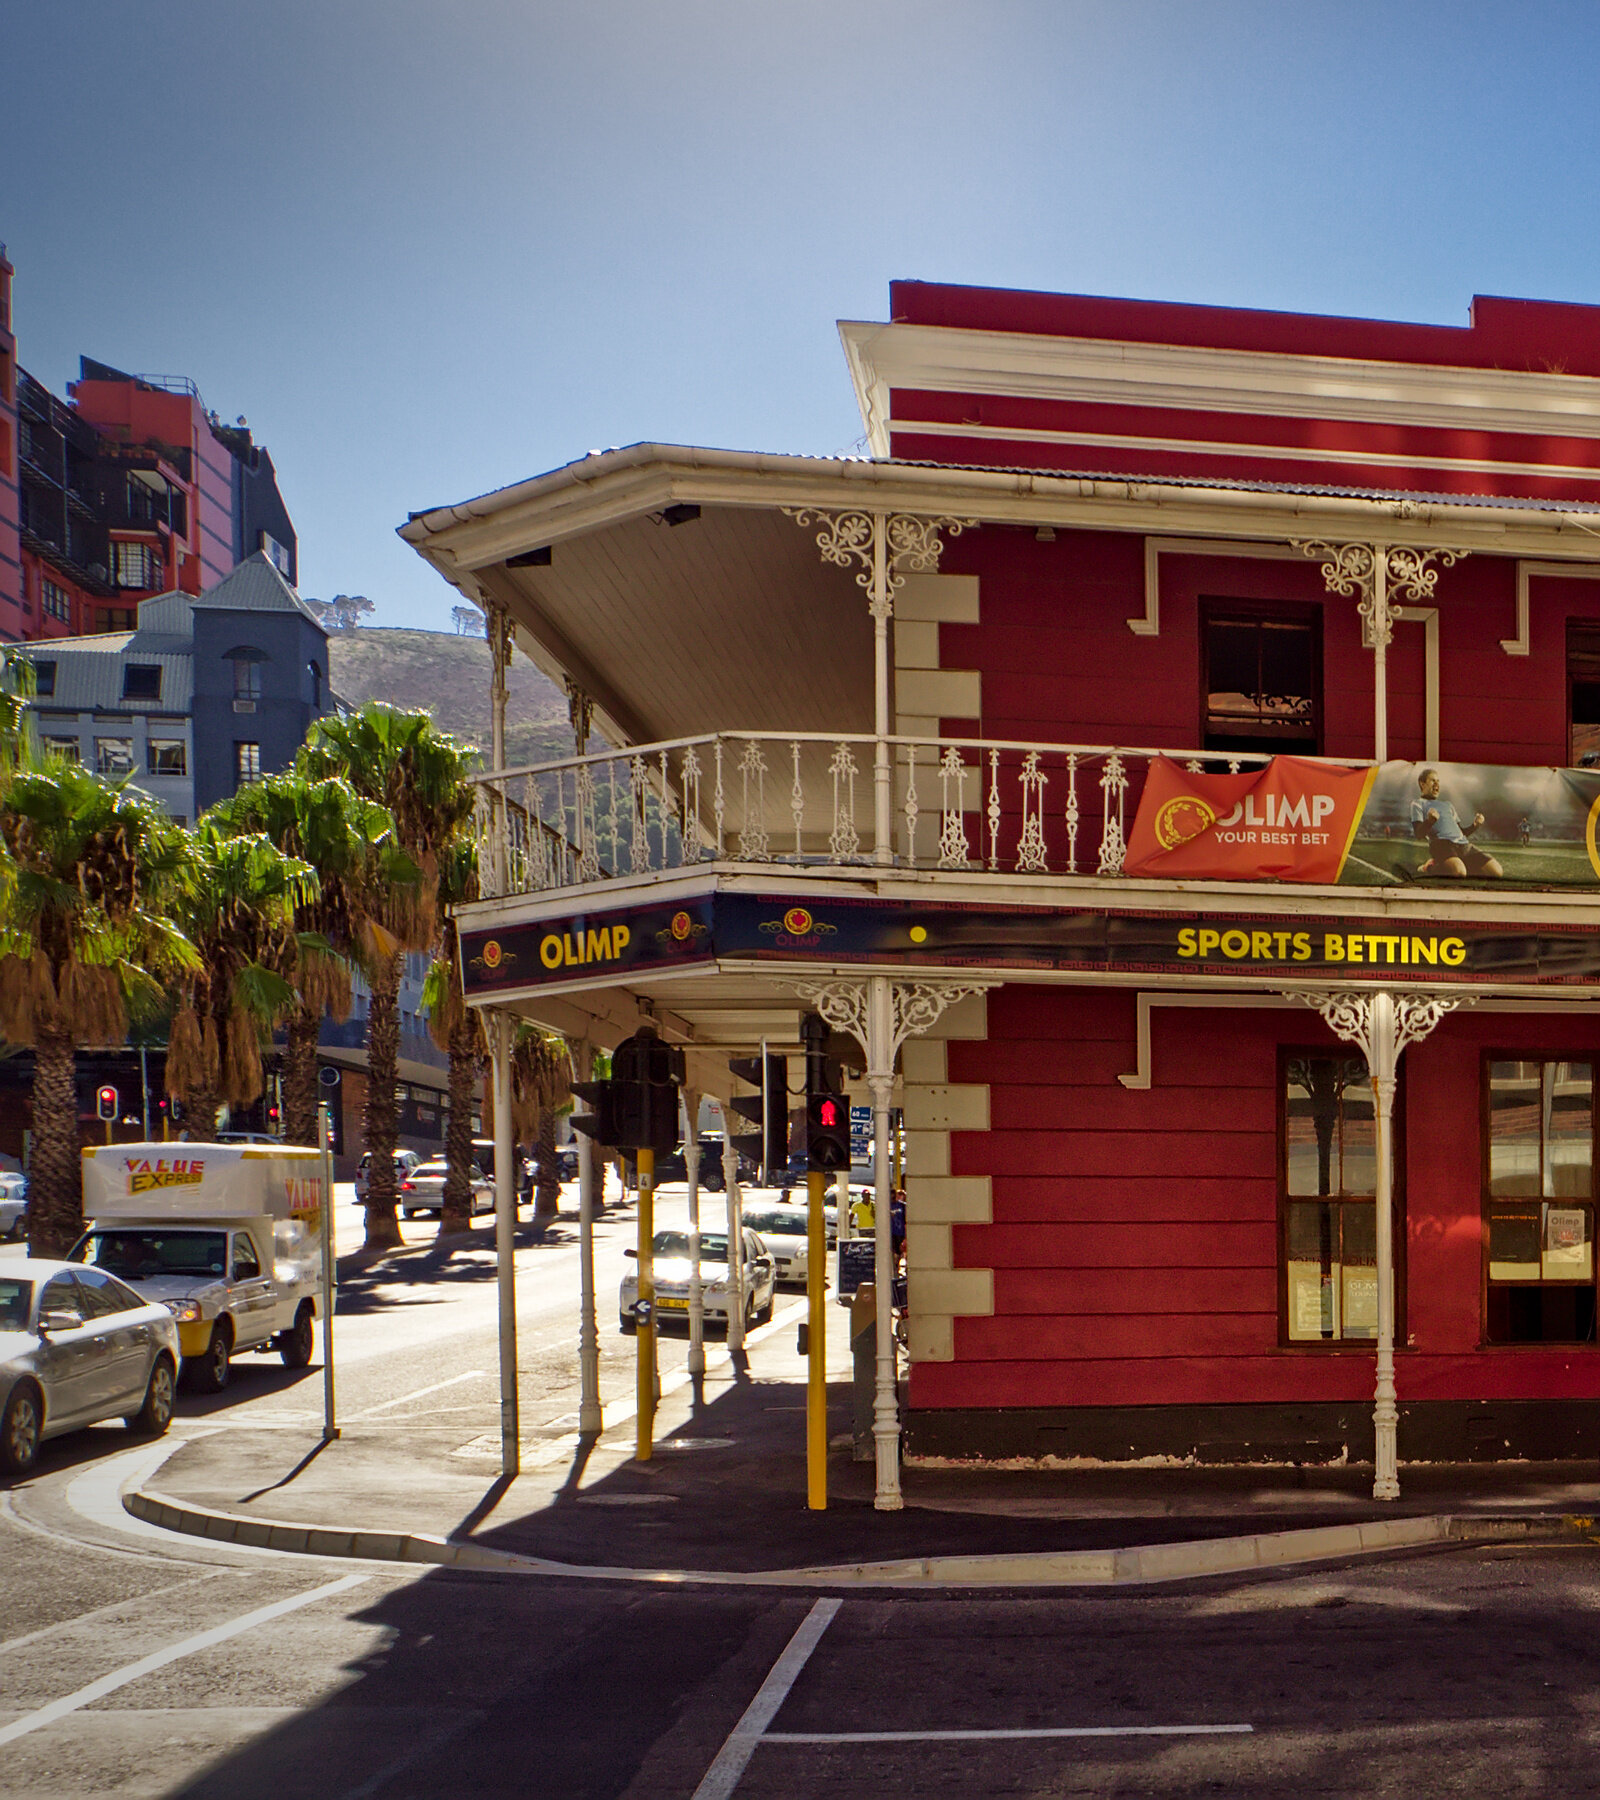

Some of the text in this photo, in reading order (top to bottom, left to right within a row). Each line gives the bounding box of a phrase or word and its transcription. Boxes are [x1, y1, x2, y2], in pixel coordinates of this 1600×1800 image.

[1215, 831, 1330, 845] YOUR BEST BET
[540, 925, 630, 969] OLIMP
[775, 934, 821, 946] OLIMP
[1177, 928, 1466, 965] SPORTS BETTING
[126, 1159, 204, 1174] VALUE
[131, 1173, 201, 1192] EXPRESS
[640, 1176, 647, 1187] 4
[1551, 1216, 1579, 1226] Olimp
